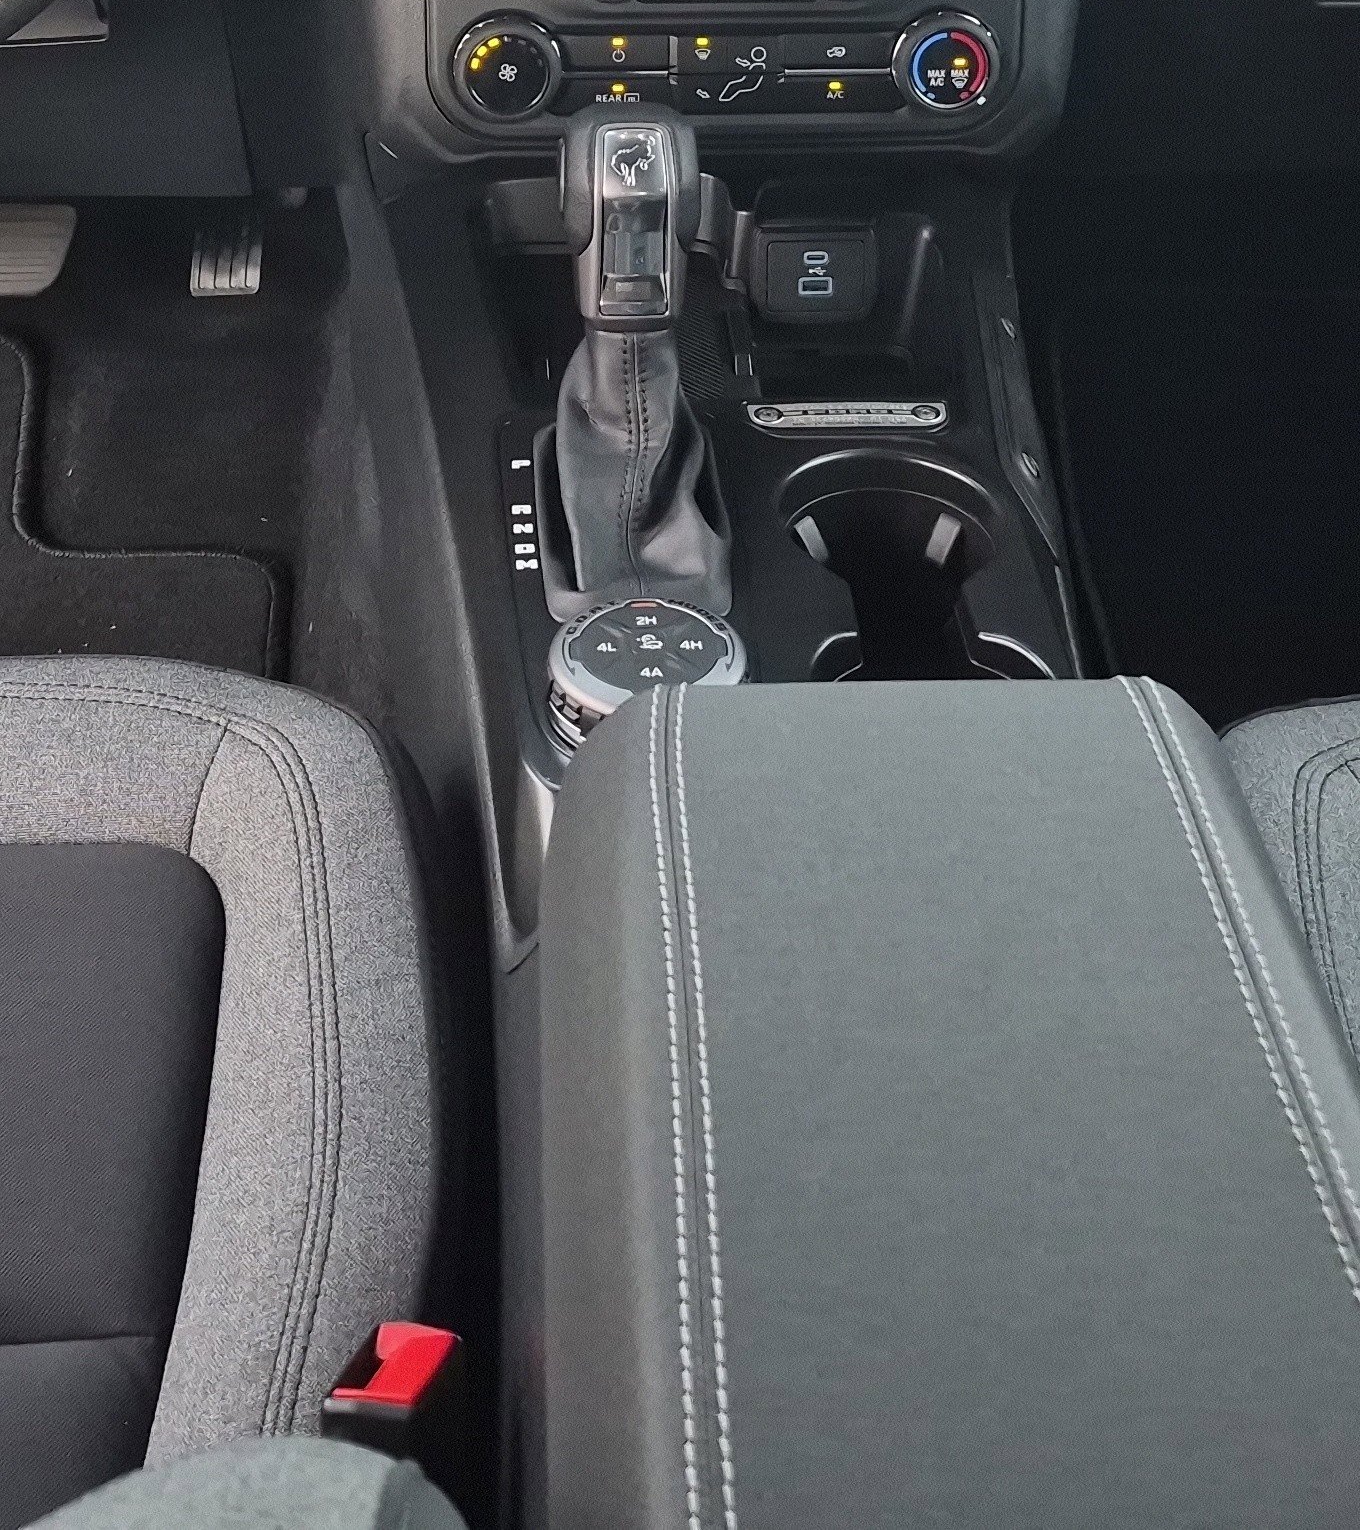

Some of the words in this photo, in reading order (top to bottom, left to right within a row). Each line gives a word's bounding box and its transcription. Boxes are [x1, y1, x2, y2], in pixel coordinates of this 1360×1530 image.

[927, 70, 946, 78] MAX
[950, 69, 970, 78] MAX
[930, 78, 945, 87] A/C
[595, 94, 622, 103] REAR
[826, 90, 844, 100] A/C
[512, 523, 534, 534] N
[514, 544, 536, 554] D
[516, 558, 538, 570] M
[635, 616, 658, 626] 2H
[596, 642, 616, 652] 4L
[679, 640, 704, 650] 4H
[640, 666, 664, 678] 4A
